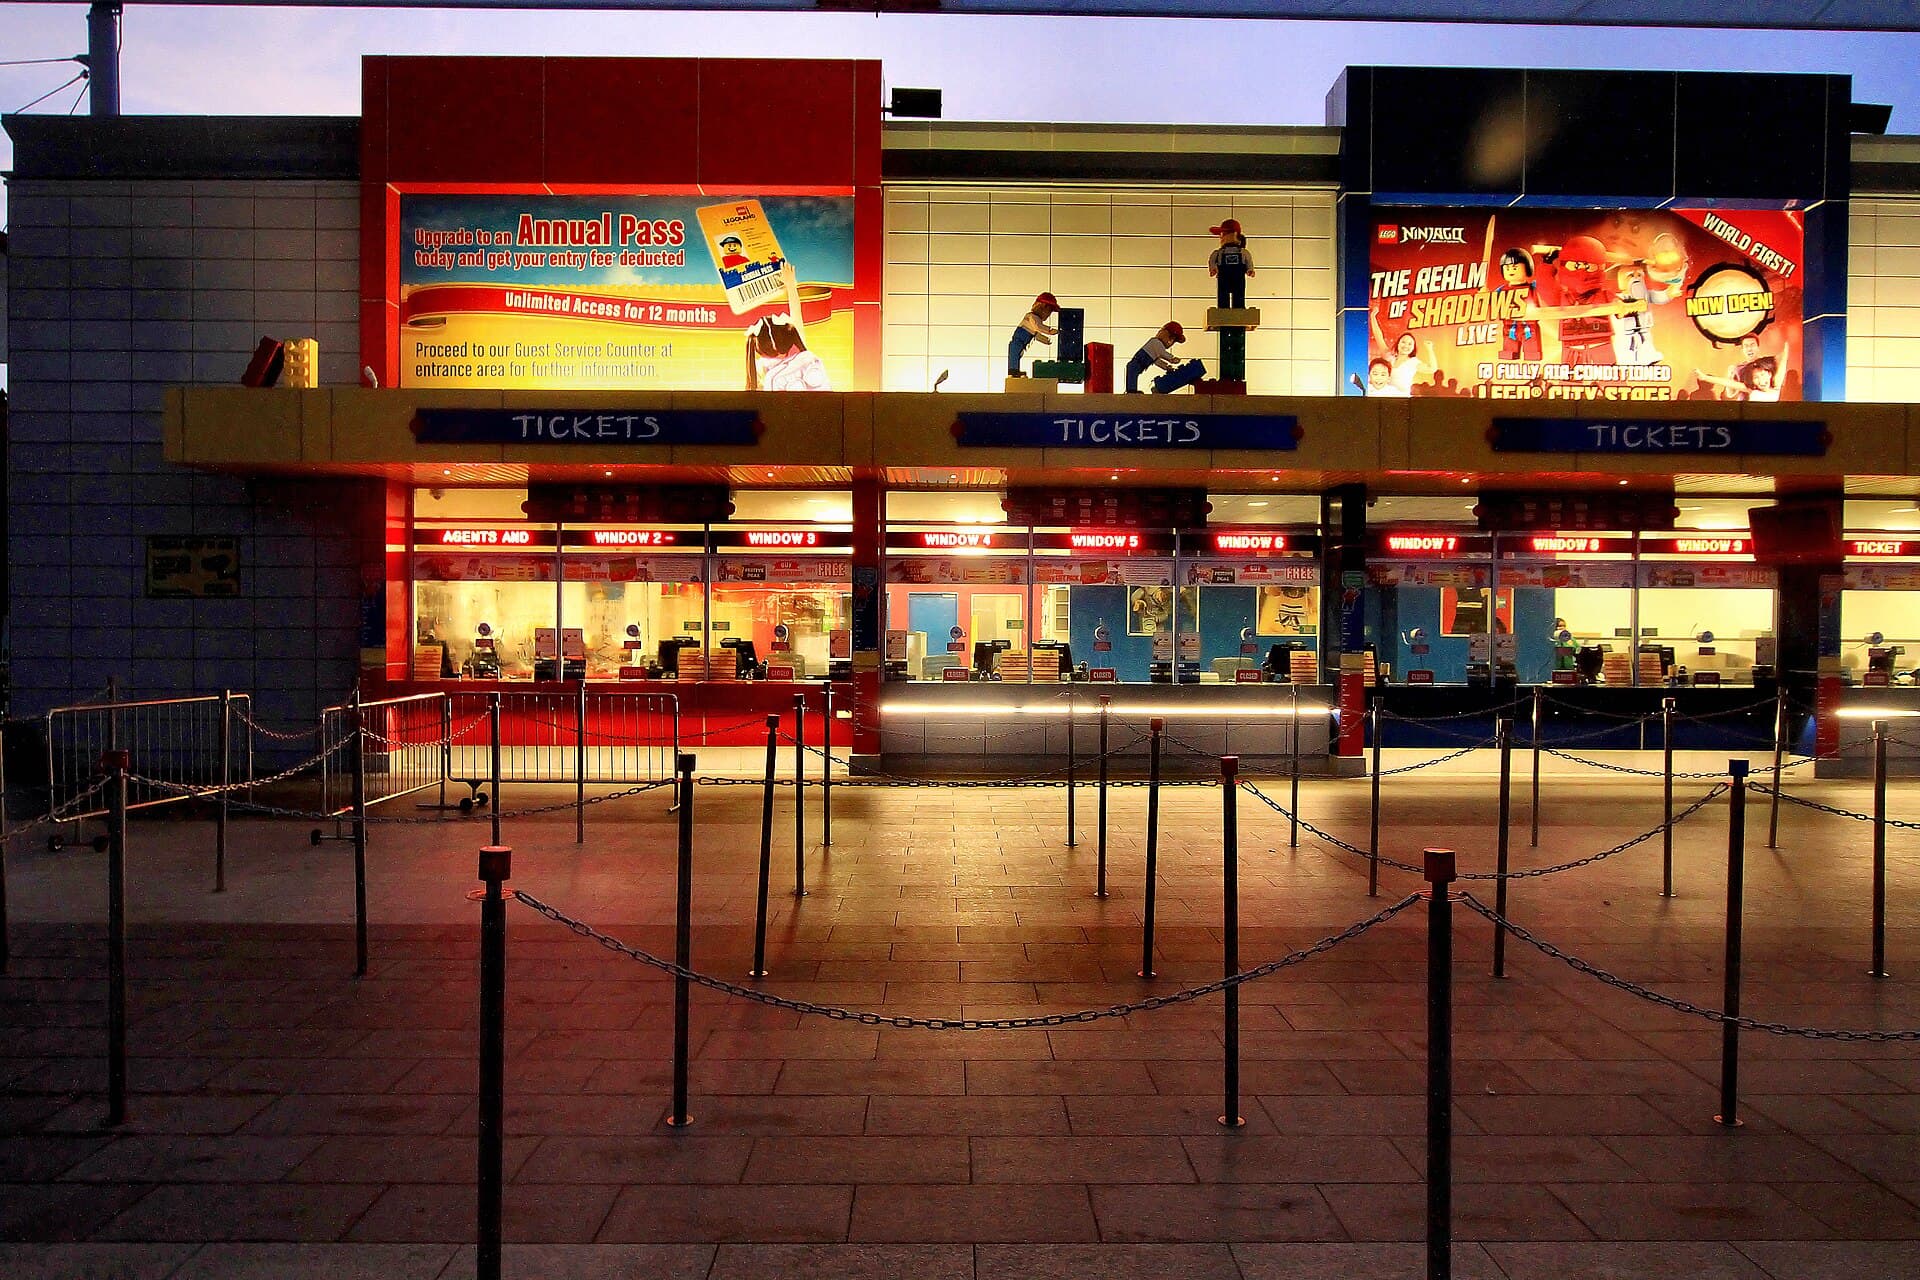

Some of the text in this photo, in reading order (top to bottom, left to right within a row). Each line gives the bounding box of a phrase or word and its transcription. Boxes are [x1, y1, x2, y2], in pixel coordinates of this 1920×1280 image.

[415, 212, 685, 249] Upgrade to an Annual Pass
[1379, 226, 1467, 244] LEGO NINJAGO
[1703, 211, 1796, 278] WORLD FIRST!
[415, 249, 455, 271] today
[458, 248, 484, 266] and
[487, 250, 511, 271] get
[514, 252, 546, 271] your
[549, 250, 588, 271] entry
[618, 248, 686, 267] deducted
[1371, 261, 1488, 299] THE REALM
[505, 291, 717, 324] Unlimited Access for 12 months
[1389, 288, 1529, 329] OF SHADOWS
[1686, 292, 1774, 316] NOW OPEN!
[1456, 323, 1498, 346] LIVE
[416, 341, 673, 358] Proceed to our Guest Service Counter at
[415, 362, 473, 377] entrance
[477, 364, 505, 377] area
[510, 361, 527, 377] for
[532, 361, 576, 377] further
[1496, 363, 1540, 381] FULLY
[1543, 364, 1672, 382] AIR-CONDITIONED
[512, 415, 660, 438] TICKETS
[1053, 419, 1201, 442] TICKETS
[1587, 425, 1733, 448] TICKETS
[443, 531, 530, 543] AGENTS AND
[594, 532, 649, 543] WINDOW
[653, 532, 662, 543] 2
[748, 532, 816, 544] WINDOW 3
[924, 533, 991, 545] WINDOW 4
[1071, 535, 1138, 547] WINDOW 5
[1217, 535, 1284, 548] WINDOW 6
[1389, 537, 1456, 550] WINDOW 7
[1533, 538, 1600, 550] WINDOW 8
[1676, 540, 1743, 551] WINDOW 9
[1854, 542, 1902, 553] TICKET
[817, 561, 846, 576] FREE
[1286, 566, 1314, 580] FREE
[1093, 671, 1112, 679] CLOSED
[1239, 672, 1258, 680] CLOSED
